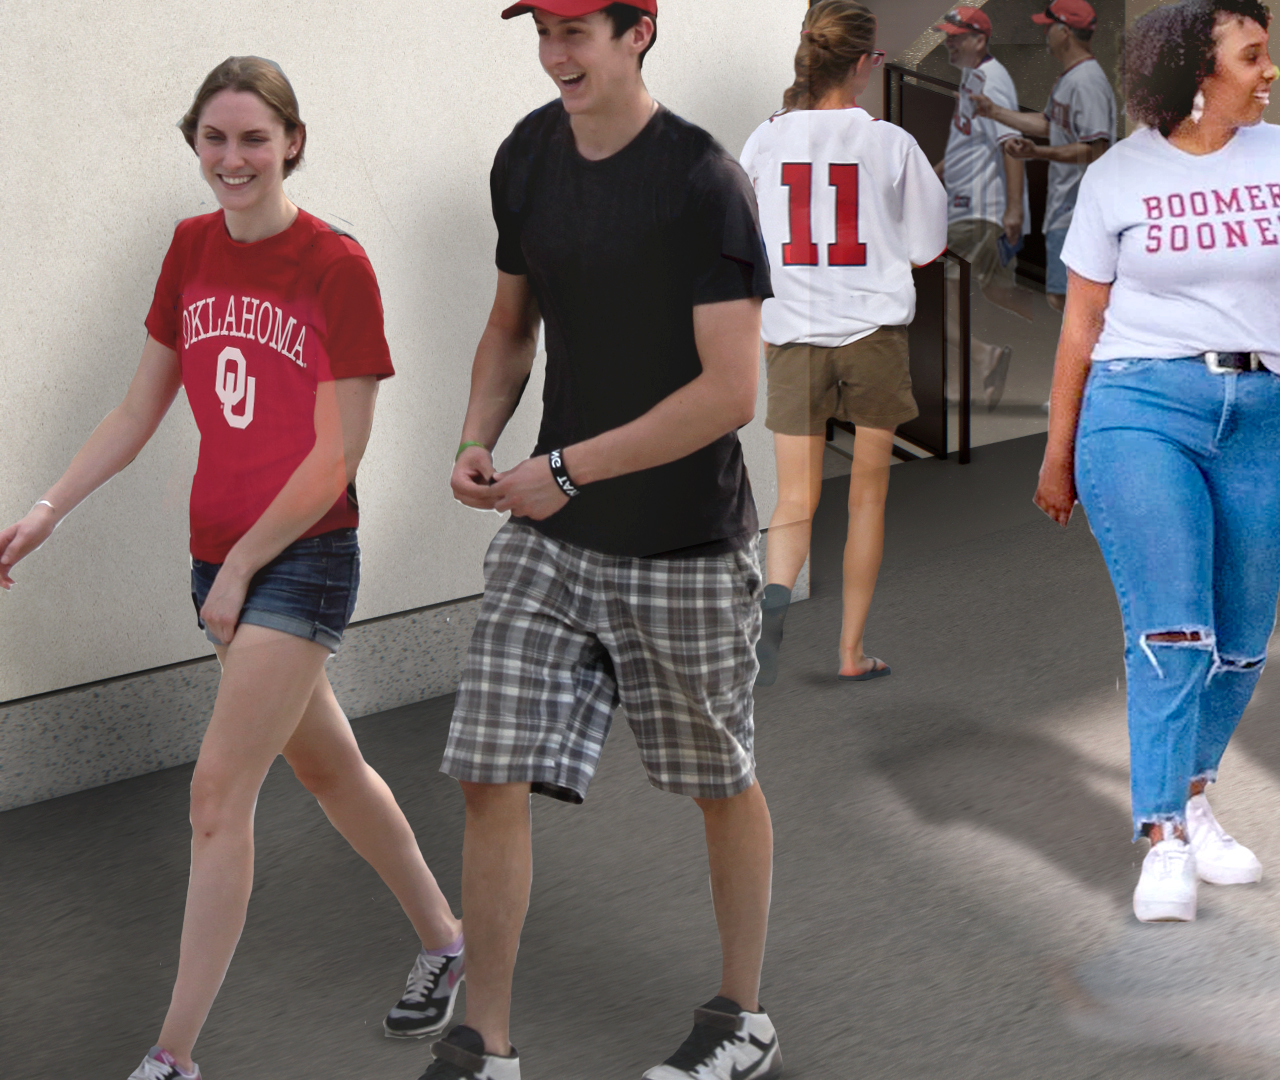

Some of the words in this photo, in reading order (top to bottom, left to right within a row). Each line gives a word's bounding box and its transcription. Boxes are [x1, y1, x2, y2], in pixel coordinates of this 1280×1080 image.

[780, 162, 867, 267] 11
[183, 295, 305, 368] OKLAHOMA
[215, 346, 256, 430] OU
